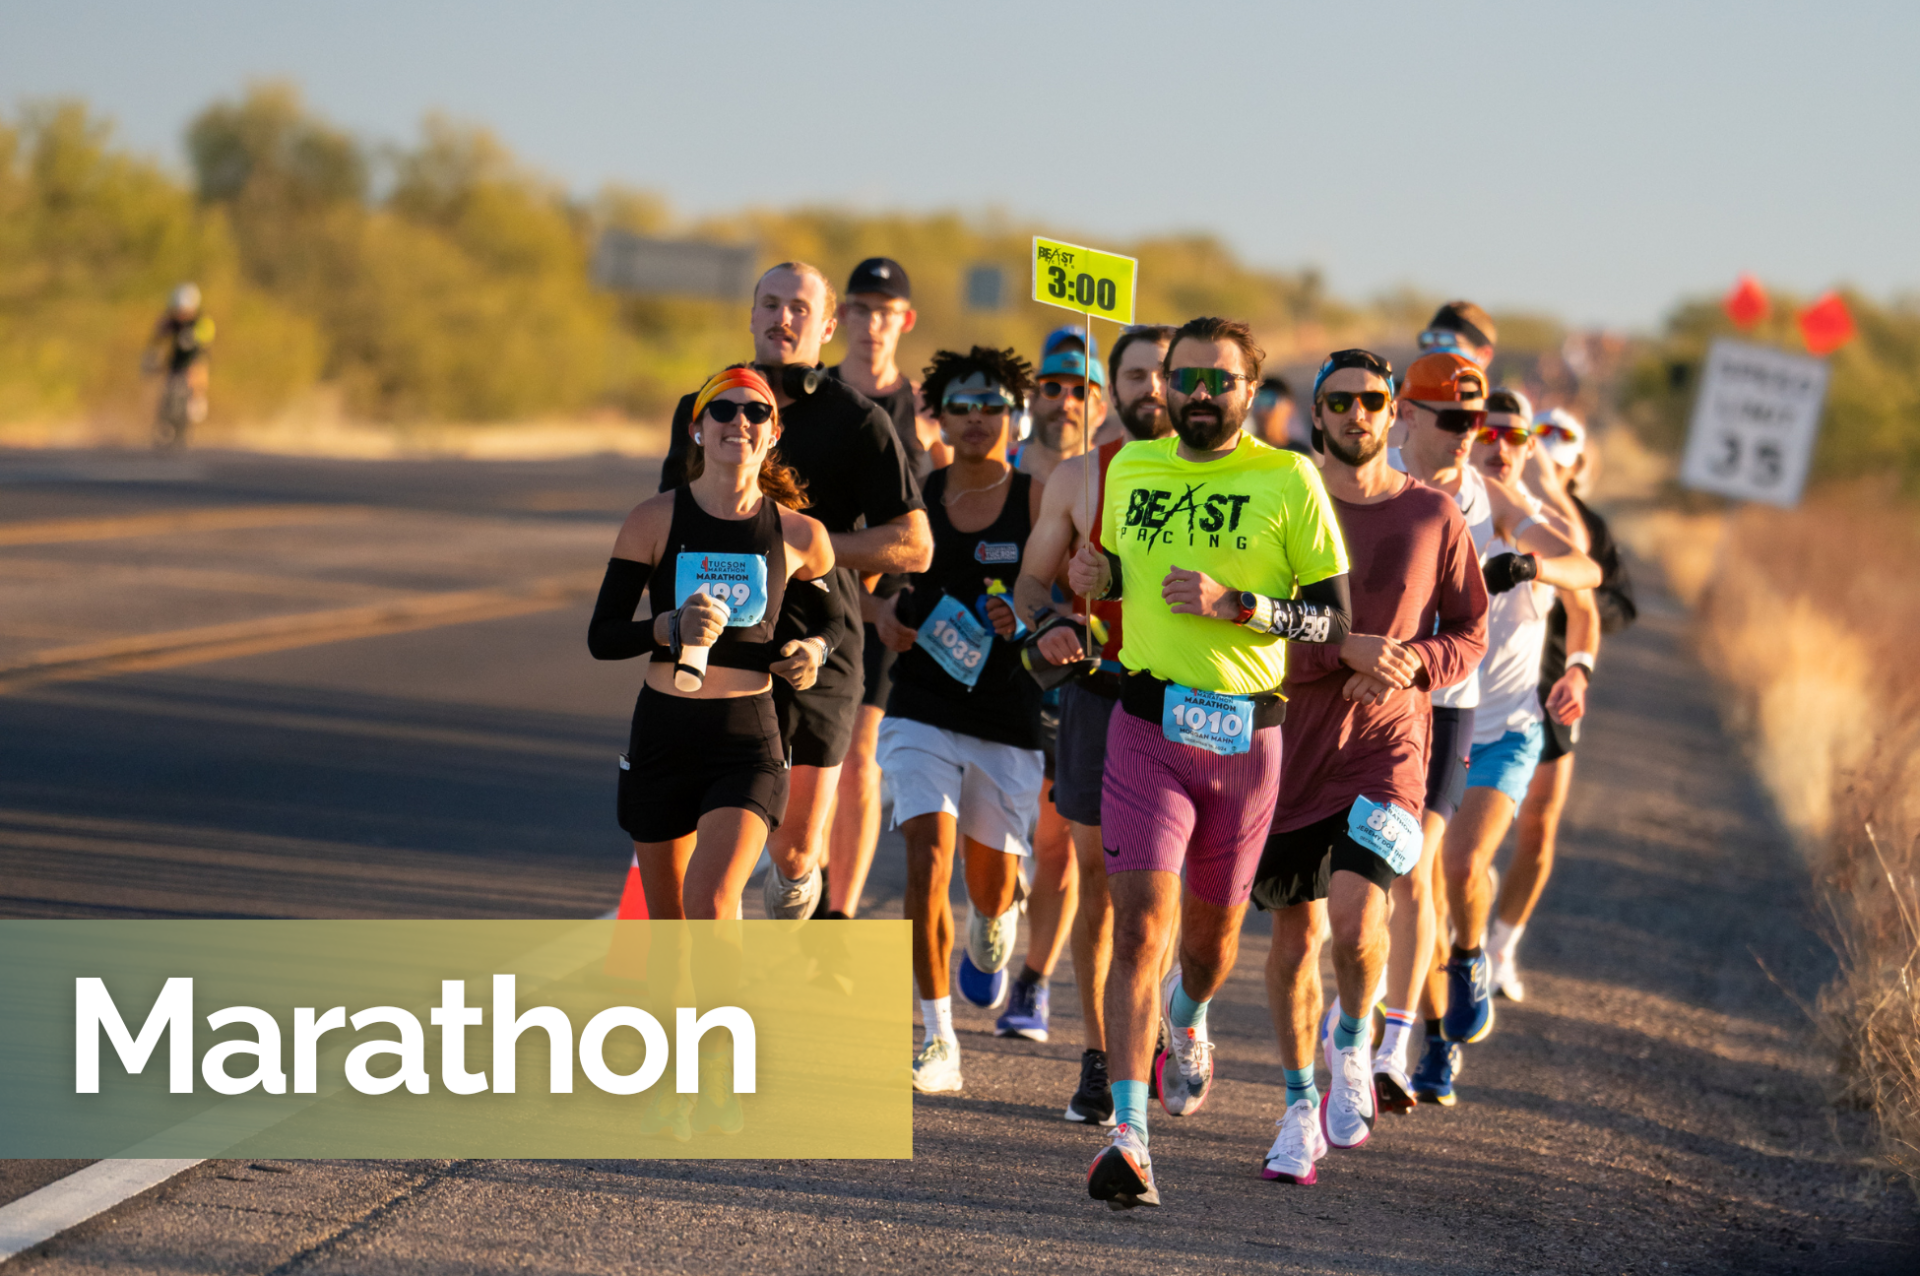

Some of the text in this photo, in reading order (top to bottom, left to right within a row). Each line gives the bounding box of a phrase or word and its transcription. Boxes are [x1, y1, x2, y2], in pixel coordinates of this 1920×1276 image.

[1038, 246, 1075, 265] BEAST
[1048, 265, 1116, 311] 3:00
[1124, 482, 1251, 555] BEAST
[1120, 527, 1247, 550] PACING
[708, 560, 746, 568] TUCSON
[696, 573, 749, 581] MARATHON
[1273, 600, 1331, 617] PACIN
[1268, 601, 1330, 642] BEAS
[933, 620, 982, 668] 1033
[1184, 696, 1237, 712] MARATHON
[1197, 692, 1234, 704] MARATHON
[1172, 704, 1243, 737] 1010
[1179, 727, 1210, 740] MORGAN
[1211, 735, 1234, 745] MAHN
[1384, 806, 1412, 835] RATHON
[1356, 824, 1381, 841] JEREMY
